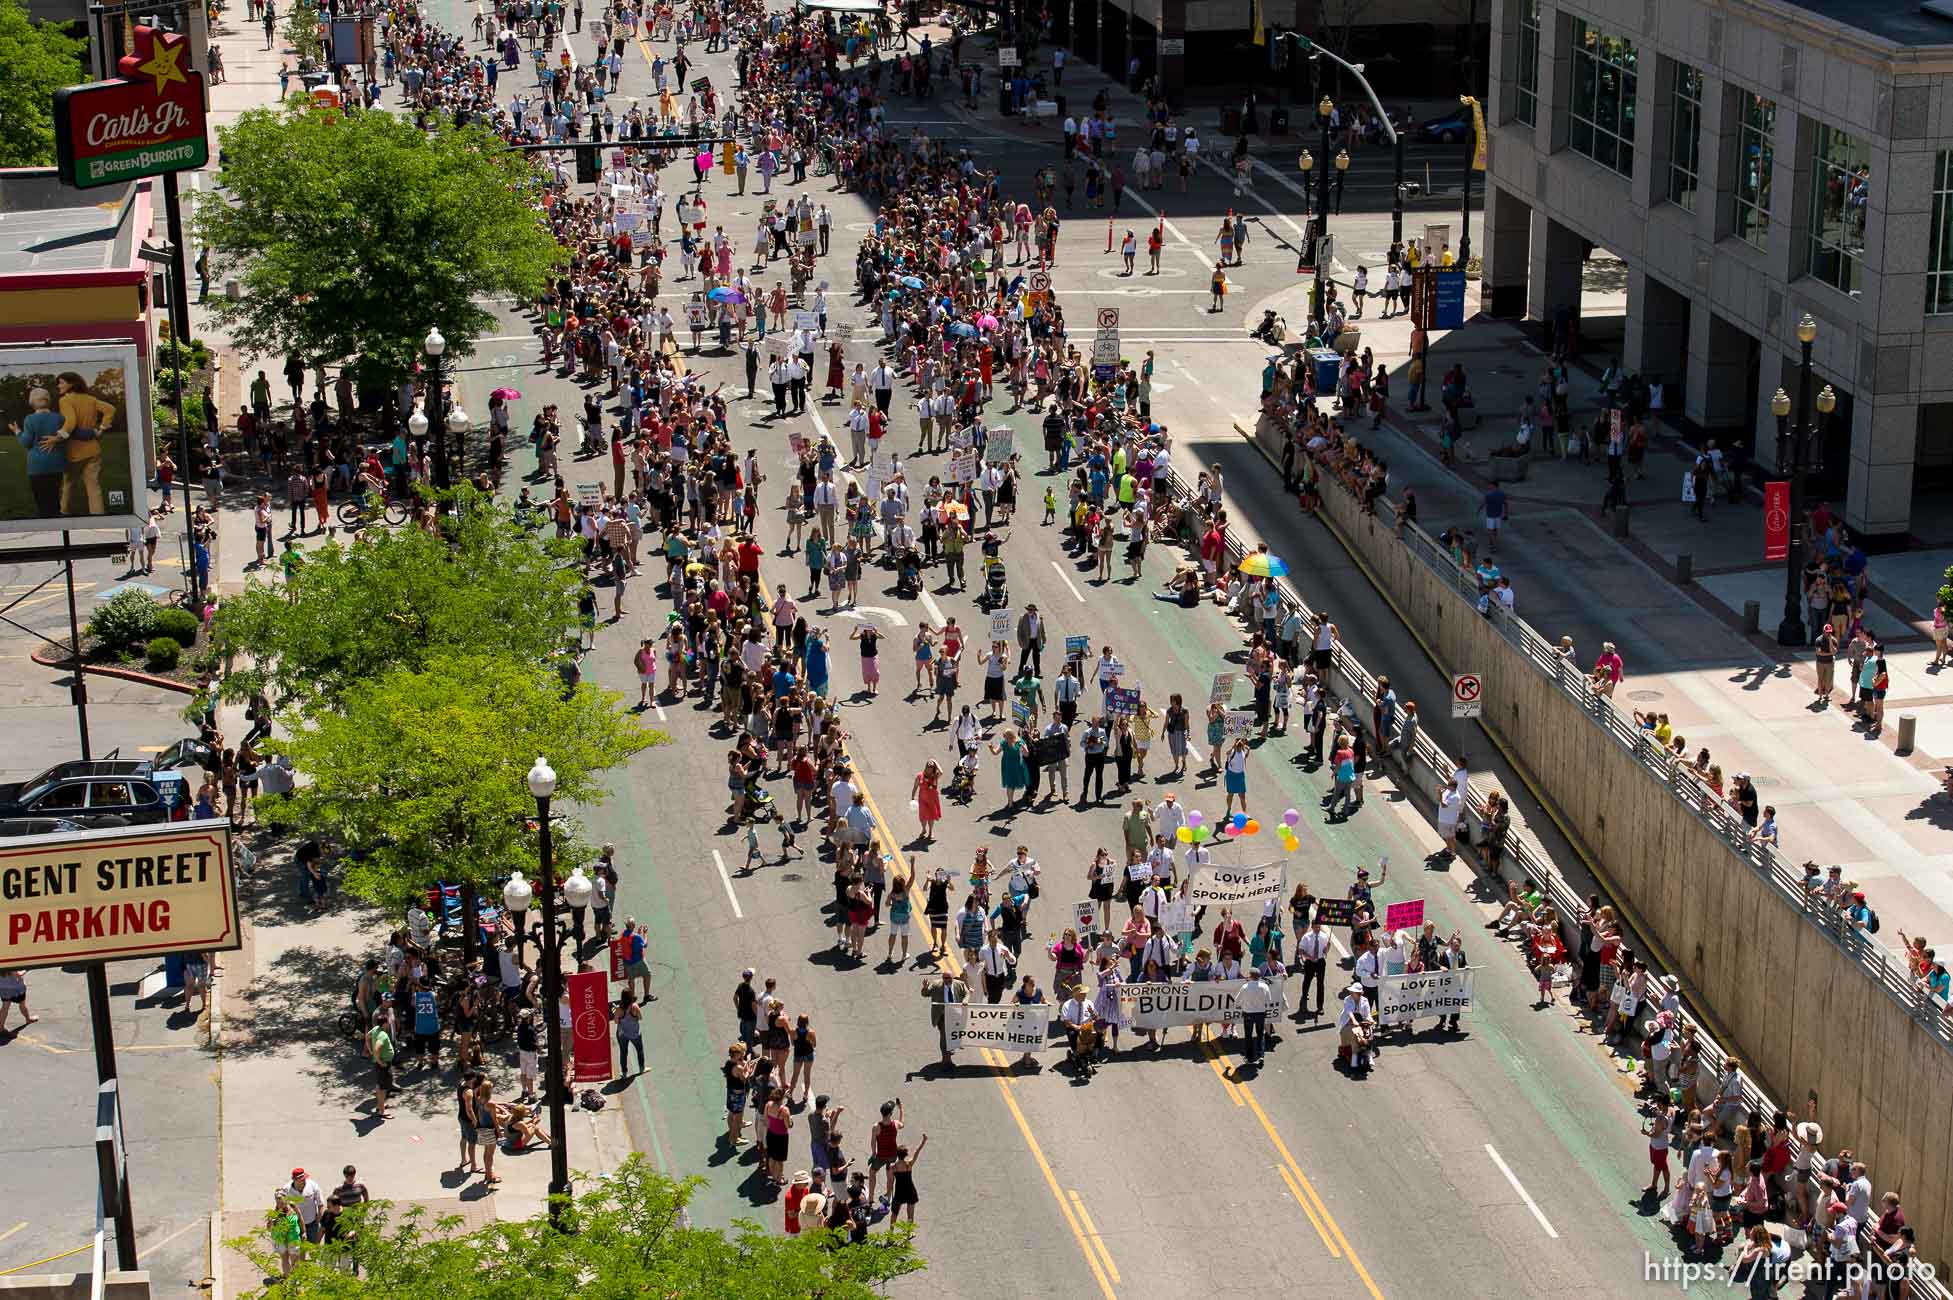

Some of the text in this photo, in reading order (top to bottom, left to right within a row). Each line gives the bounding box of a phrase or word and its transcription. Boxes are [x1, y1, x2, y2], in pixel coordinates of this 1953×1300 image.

[87, 101, 190, 146] Carl's Jr.
[97, 851, 212, 891] STREET
[1214, 872, 1265, 885] LOVE IS
[1192, 884, 1280, 901] SPOKEN HERE
[8, 899, 171, 945] PARKING
[1120, 986, 1189, 996] MORMONS
[1401, 977, 1452, 991] LOVE IS
[418, 1003, 434, 1014] 23
[1383, 997, 1469, 1015] SPOKEN HERE
[970, 1010, 1025, 1020] LOVE IS
[951, 1030, 1043, 1044] SPOKEN HERE
